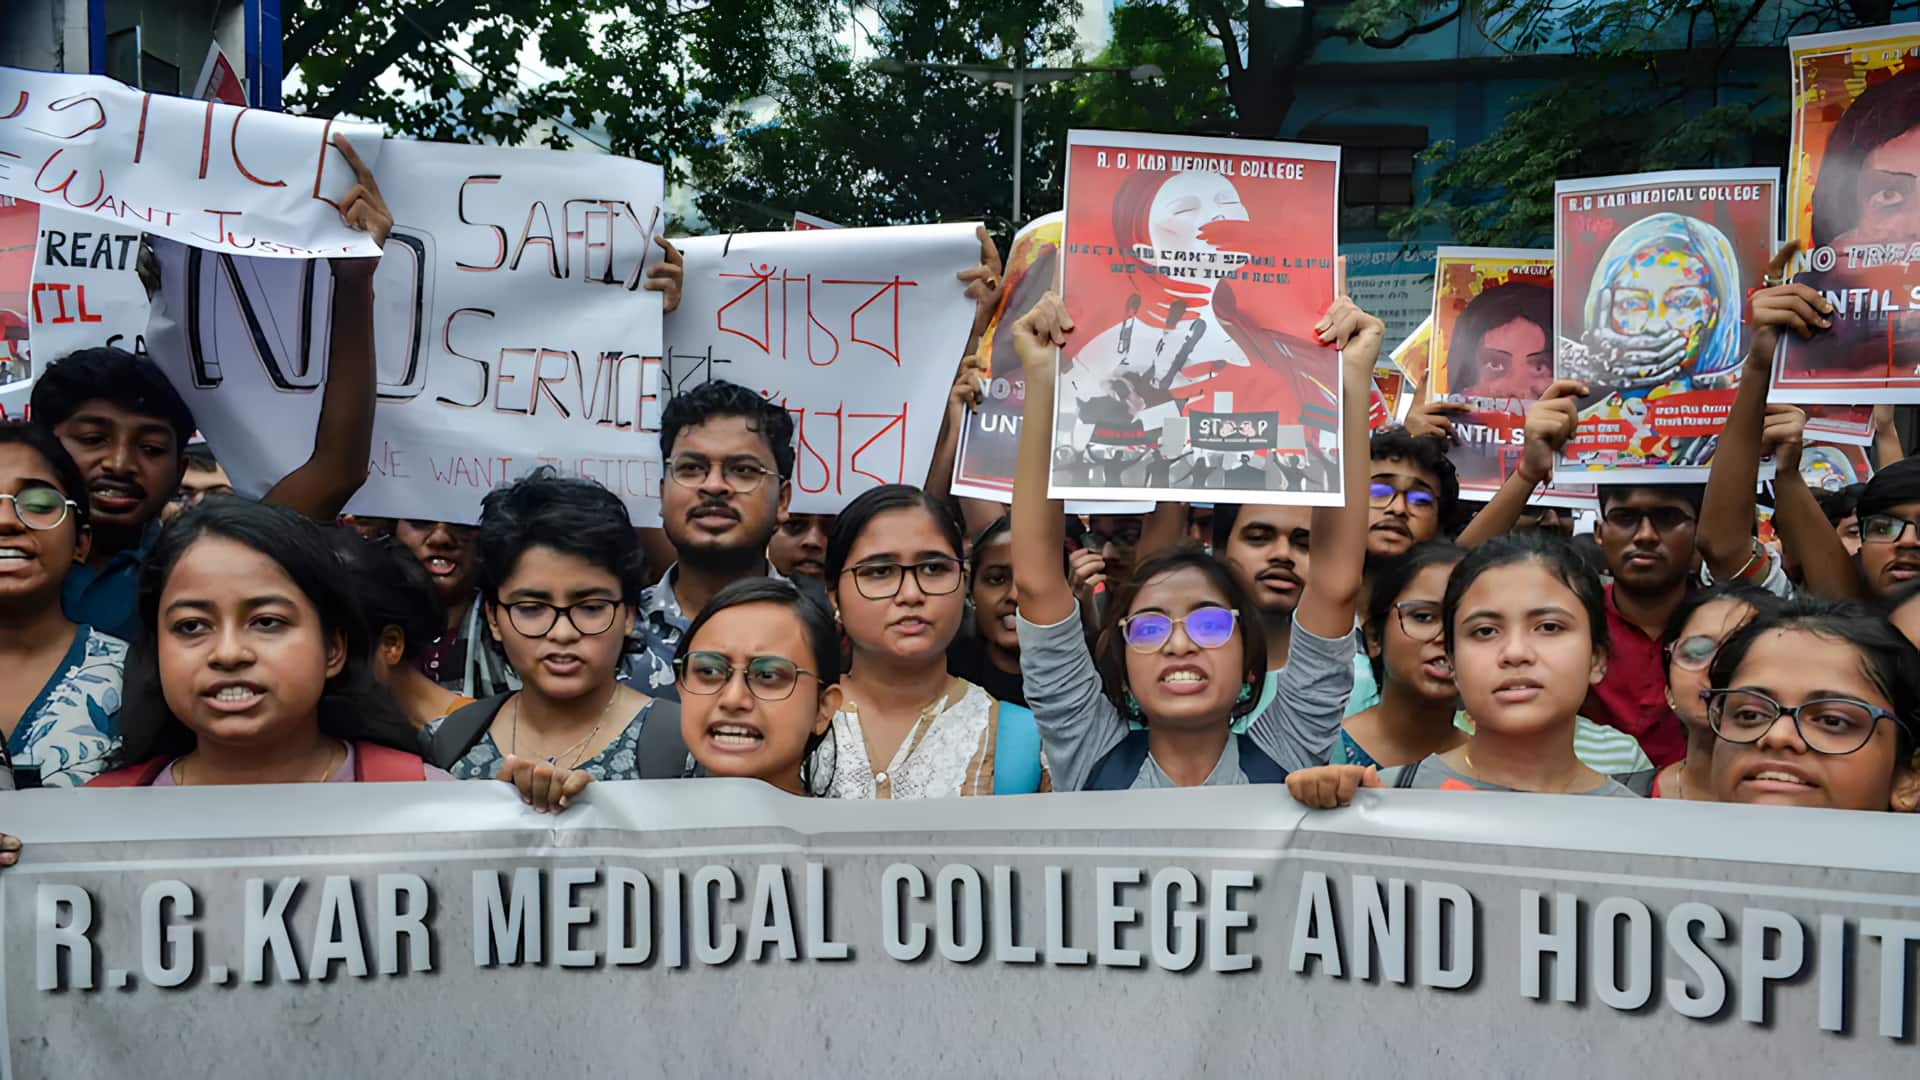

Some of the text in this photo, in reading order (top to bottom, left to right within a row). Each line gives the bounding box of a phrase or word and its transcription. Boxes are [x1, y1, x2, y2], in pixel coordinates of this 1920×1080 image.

[41, 230, 138, 271] REAT
[190, 208, 358, 257] JUST
[455, 174, 661, 292] SAFETY
[1792, 245, 1836, 273] NO
[1818, 287, 1900, 318] NTIL
[435, 307, 662, 433] SERVICE
[980, 412, 1024, 436] UN
[1451, 422, 1507, 445] NTIL
[428, 456, 513, 489] WANT
[472, 862, 849, 968] MEDICAL
[881, 862, 1256, 972] COLLEGE
[1288, 871, 1476, 990] AND
